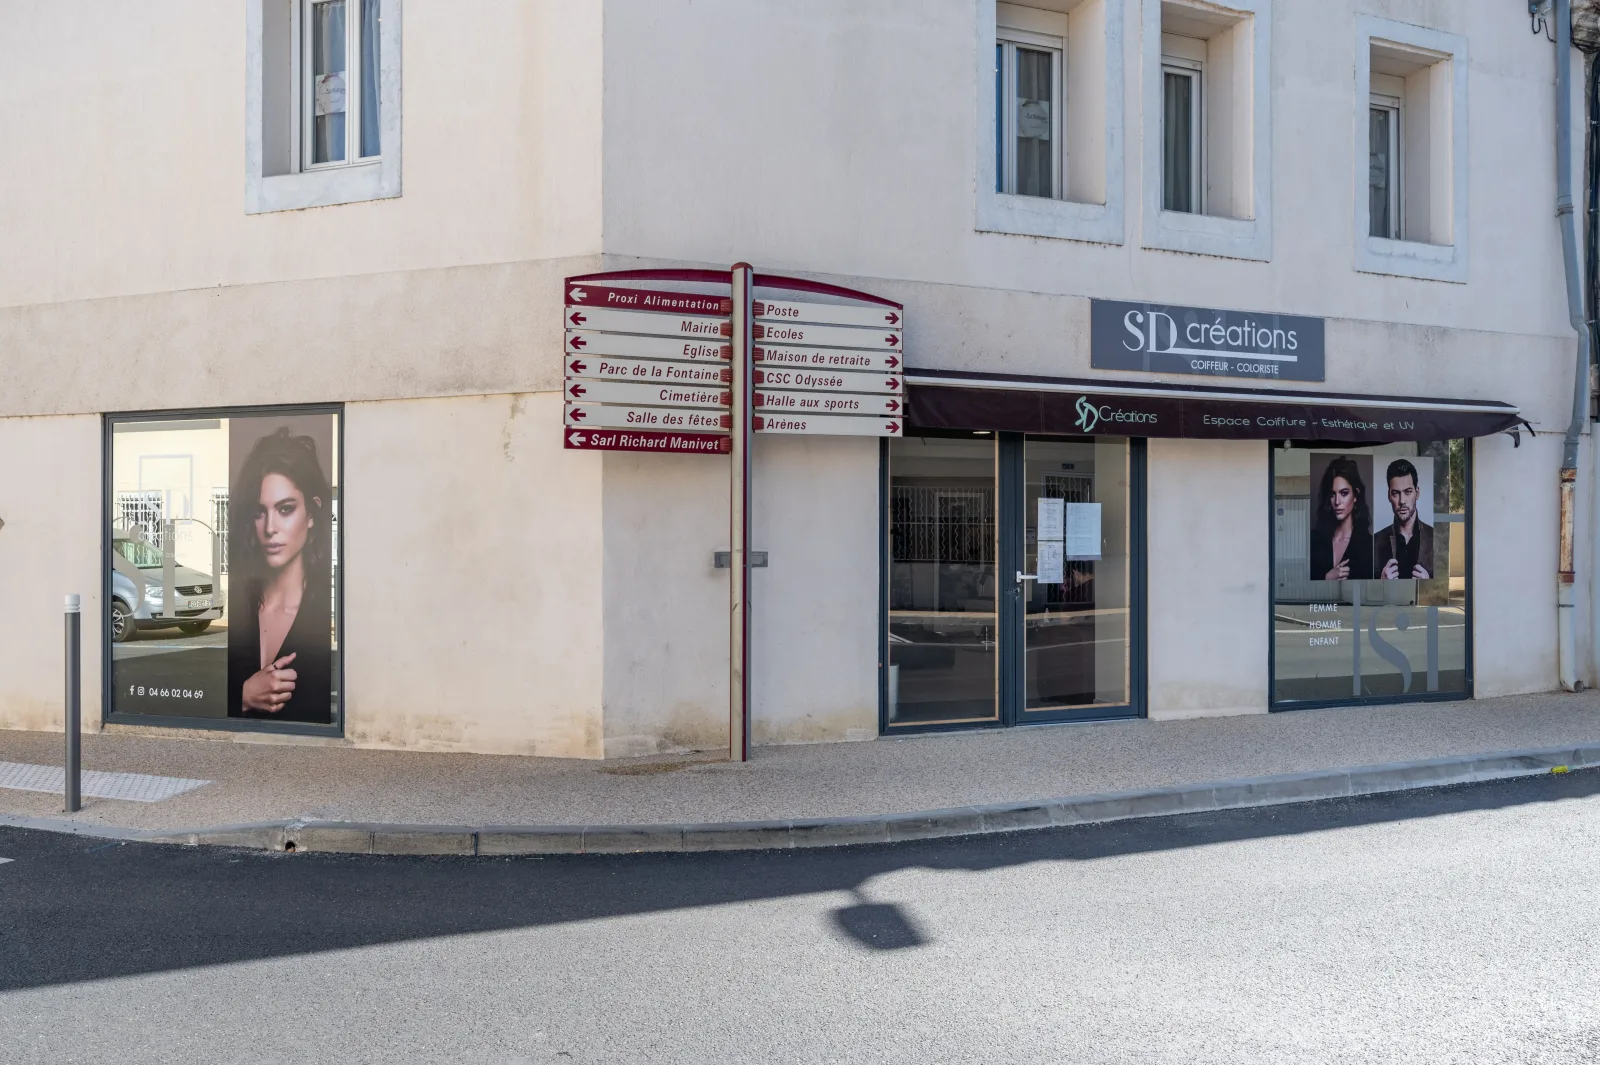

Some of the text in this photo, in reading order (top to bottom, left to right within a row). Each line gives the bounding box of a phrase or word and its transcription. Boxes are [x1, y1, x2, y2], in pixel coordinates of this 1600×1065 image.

[607, 292, 720, 310] Proxi Alimentation
[766, 304, 799, 317] Poste
[680, 320, 719, 334] Mairie
[766, 326, 804, 340] Ecoles
[1122, 310, 1298, 353] SD créations
[683, 344, 719, 359] Eglise
[766, 350, 871, 366] Maison de retraite
[599, 362, 719, 381] Parc de la Fontaine
[1190, 359, 1229, 372] COIFFEUR
[1236, 362, 1279, 374] COLORISTE
[766, 372, 843, 388] CSC Odyssée
[659, 389, 719, 404] Cimetière
[766, 394, 860, 411] Halle aux sports
[626, 411, 719, 427] Salle des fêtes
[1098, 405, 1158, 424] Créations
[766, 418, 807, 430] Arènes
[1203, 414, 1251, 431] Espace
[1256, 416, 1307, 427] Coiffure
[1321, 418, 1378, 431] Esthétique
[1383, 421, 1395, 430] et
[1399, 421, 1415, 430] UV
[590, 433, 719, 450] Sarl Richard Manivet
[1309, 603, 1338, 612] FEMME
[1309, 619, 1342, 629] HOMME
[1309, 636, 1339, 646] ENFANT
[148, 687, 158, 696] 04
[160, 688, 170, 697] 66
[171, 688, 181, 698] 02
[182, 689, 192, 698] 04
[194, 689, 204, 699] 69
